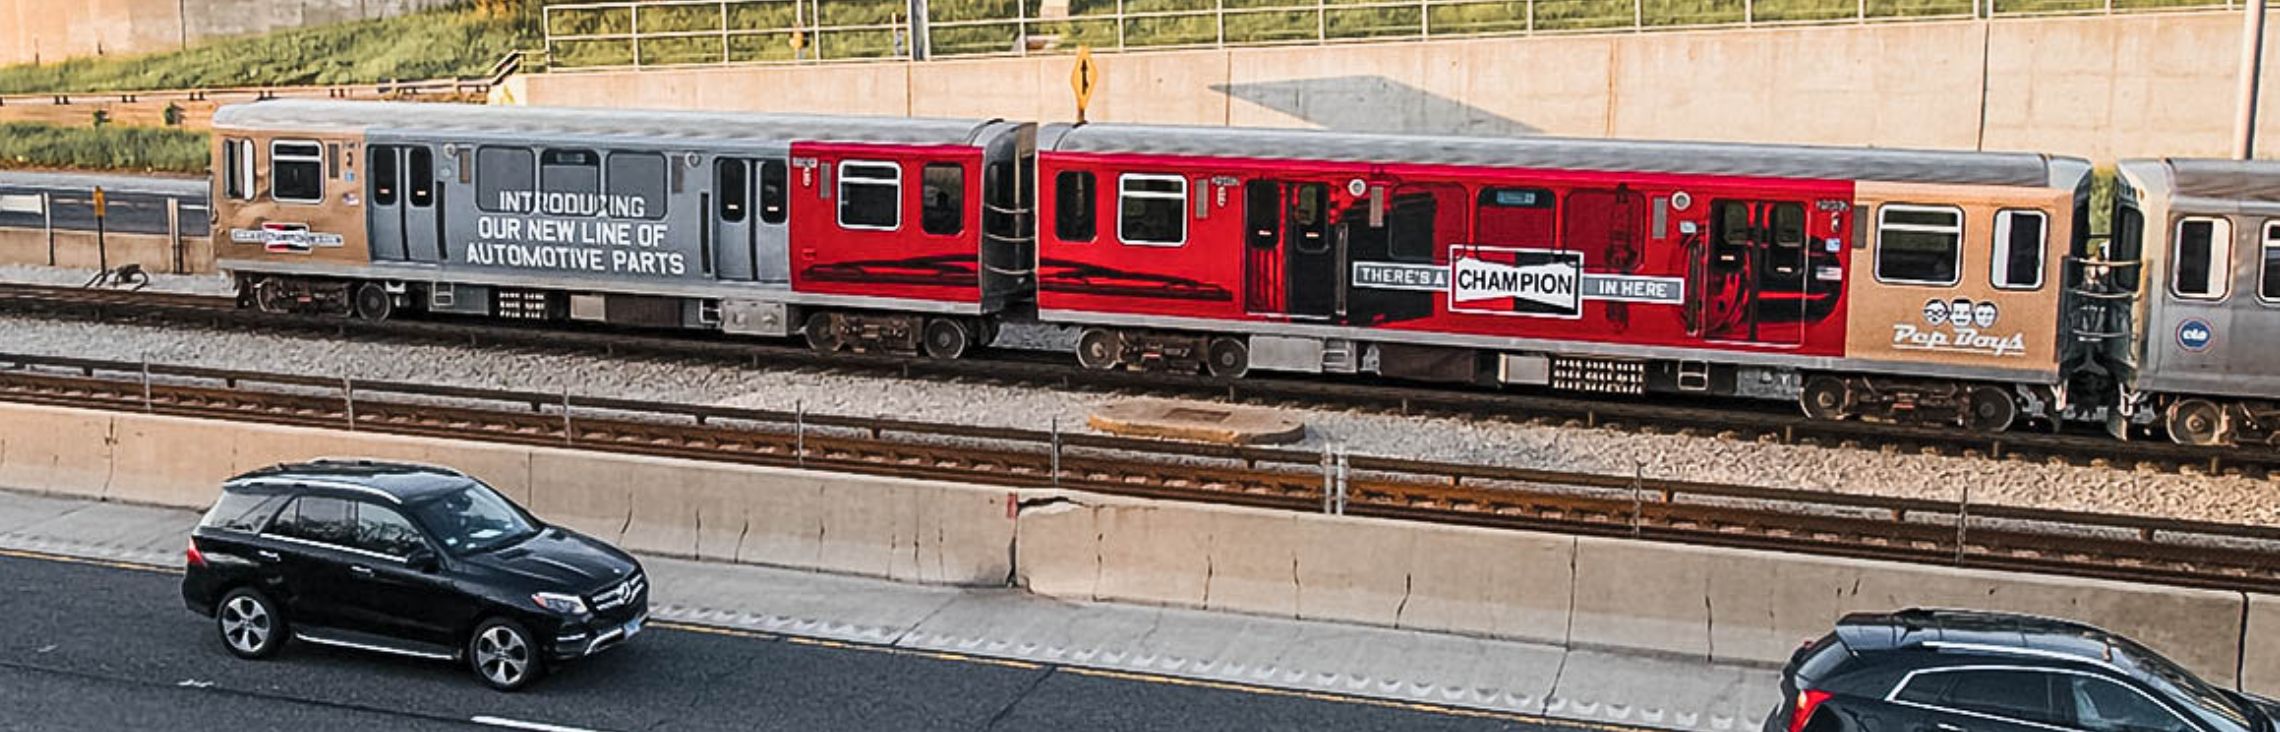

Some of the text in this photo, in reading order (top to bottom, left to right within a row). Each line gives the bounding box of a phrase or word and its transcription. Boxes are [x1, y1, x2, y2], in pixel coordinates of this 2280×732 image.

[500, 191, 646, 218] INTRODUCING
[477, 216, 668, 247] OUR NEW LINE OF
[466, 242, 686, 275] AUTOMOTIVE PARTS
[1360, 267, 1446, 285] THERE'S A
[1457, 268, 1573, 295] CHAMPION
[1599, 280, 1668, 298] IN HERE
[1953, 327, 2025, 356] Boys
